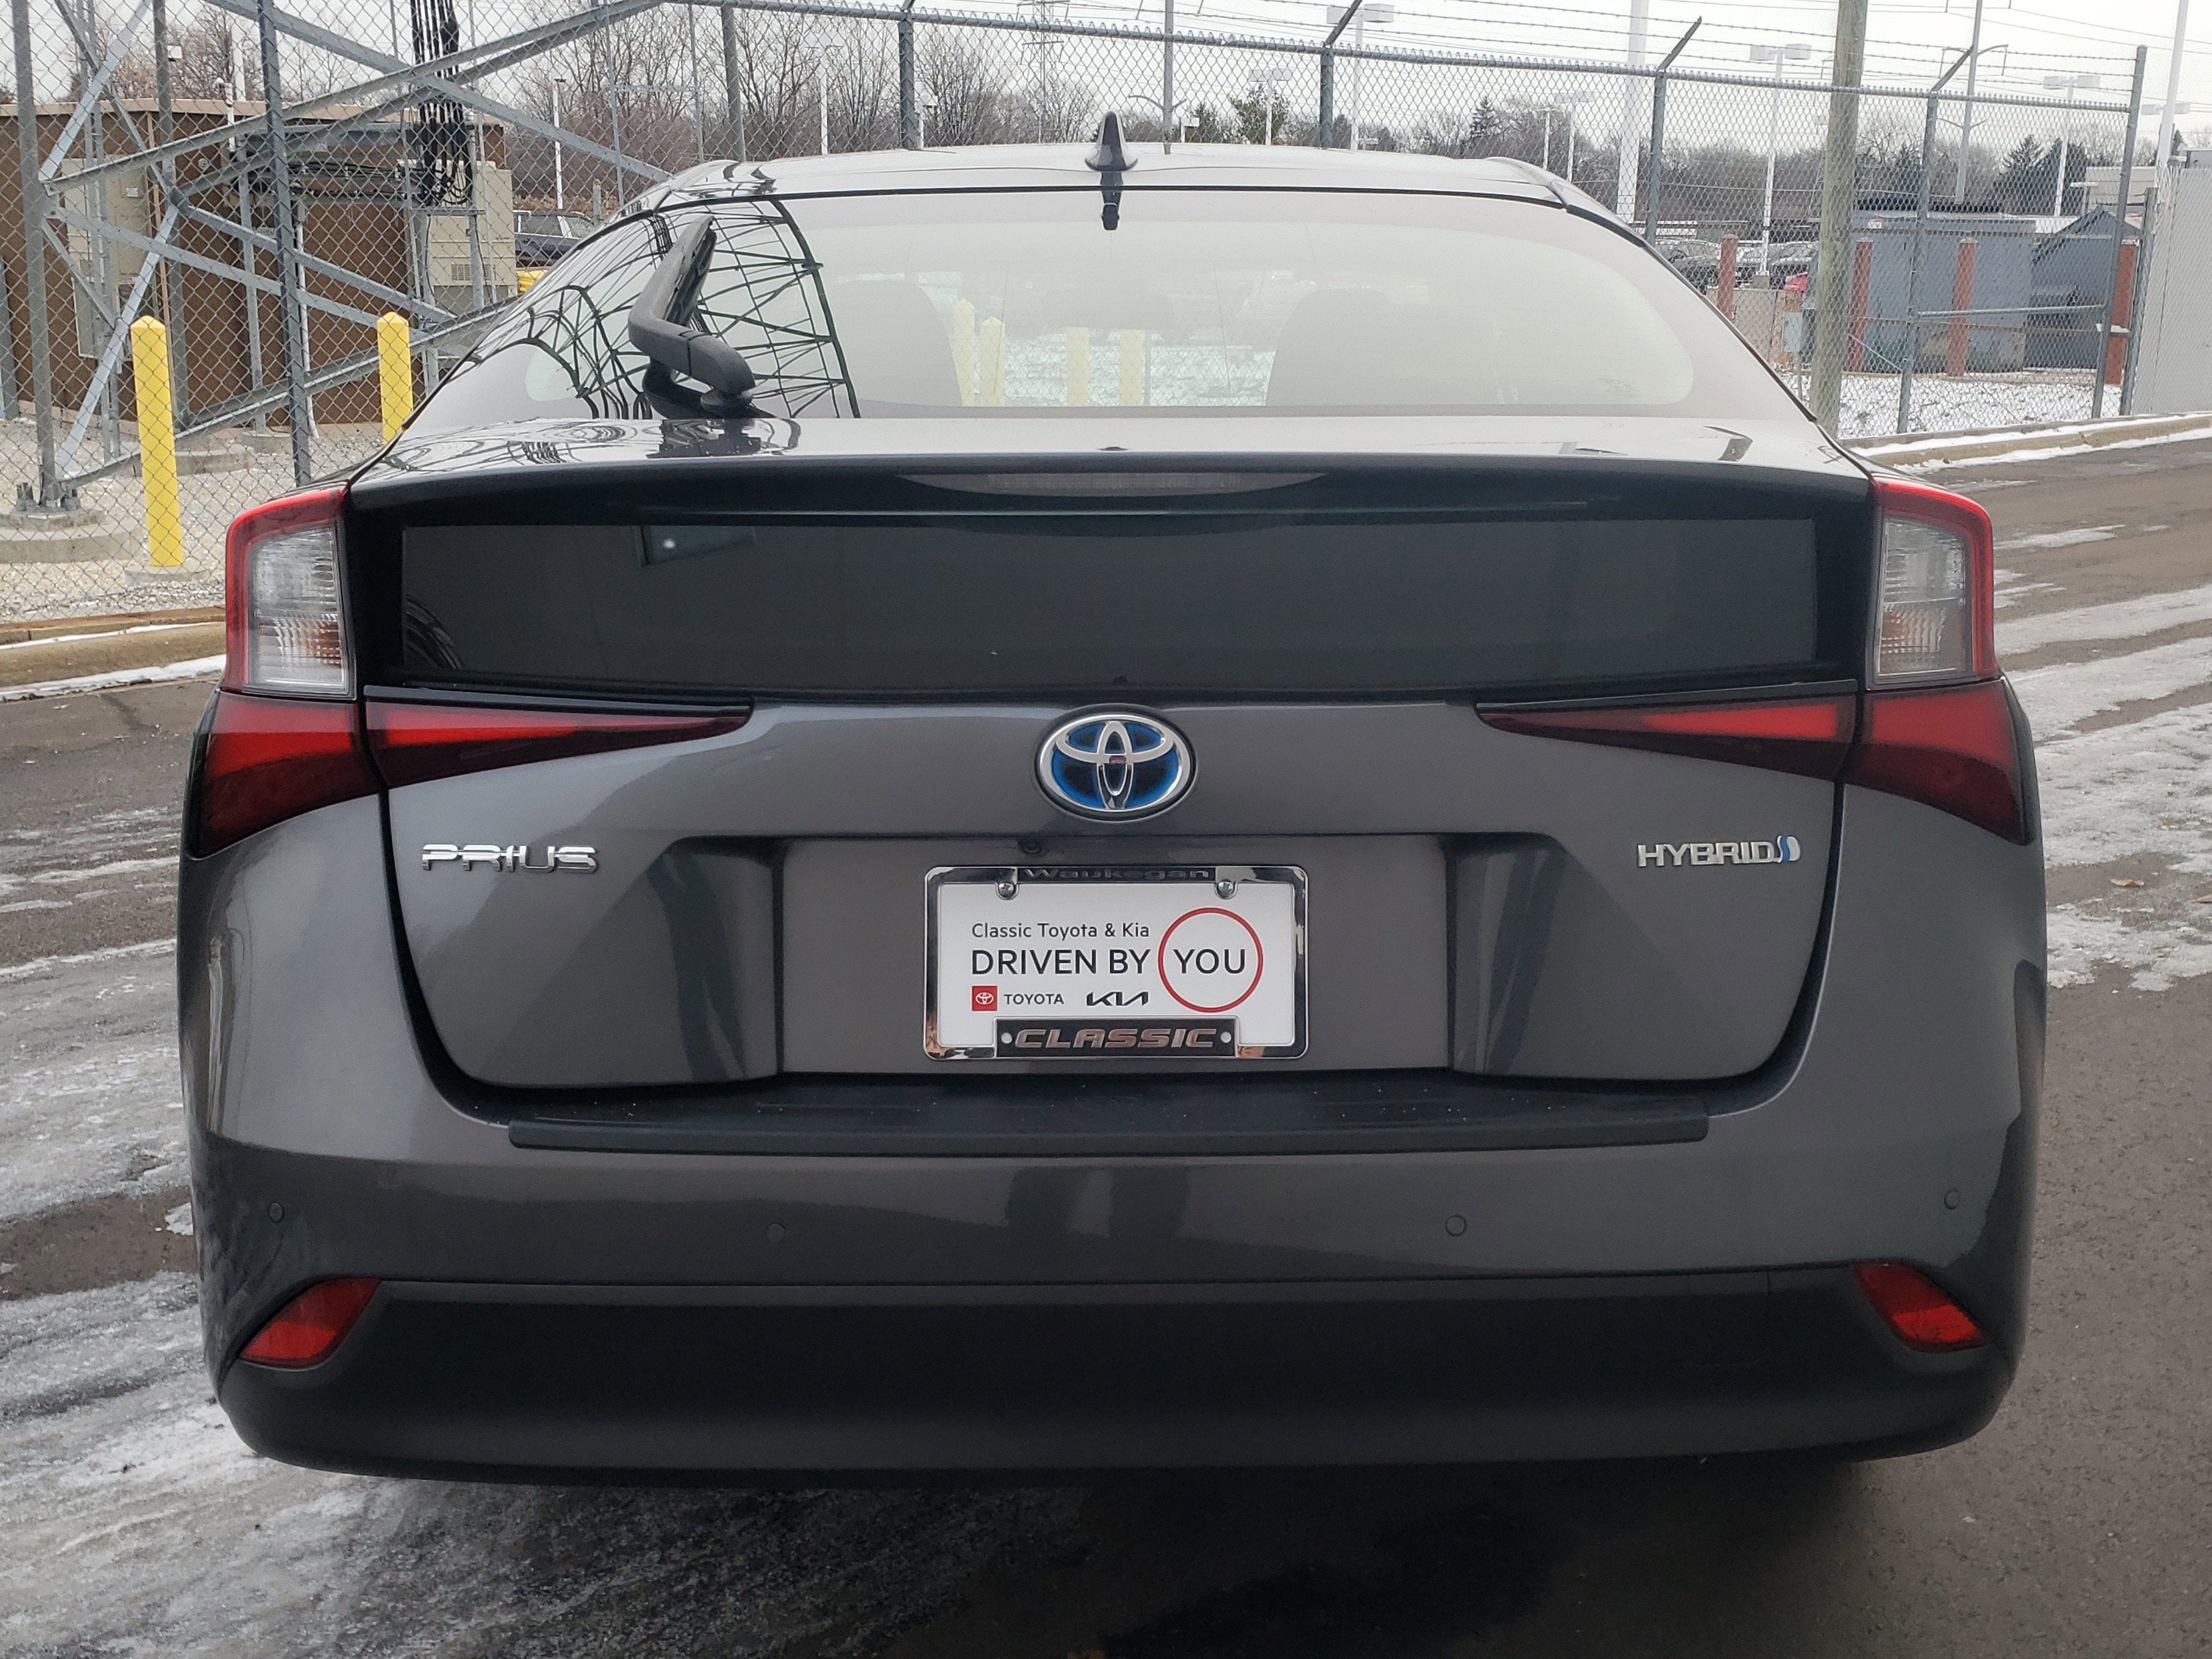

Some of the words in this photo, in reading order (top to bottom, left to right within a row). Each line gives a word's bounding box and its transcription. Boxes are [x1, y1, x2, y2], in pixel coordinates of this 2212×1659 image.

[422, 844, 596, 873] PRIUS
[1638, 842, 1775, 867] HYBRID
[972, 922, 1032, 938] Classic
[1037, 923, 1098, 941] Toyota
[1104, 922, 1116, 937] &
[1122, 922, 1149, 937] Kia
[972, 949, 1097, 974] DRIVEN
[1109, 949, 1152, 974] BY
[1173, 949, 1246, 974] YOU
[1003, 994, 1064, 1005] TOYOTA
[1015, 1029, 1217, 1048] CLASSIC
